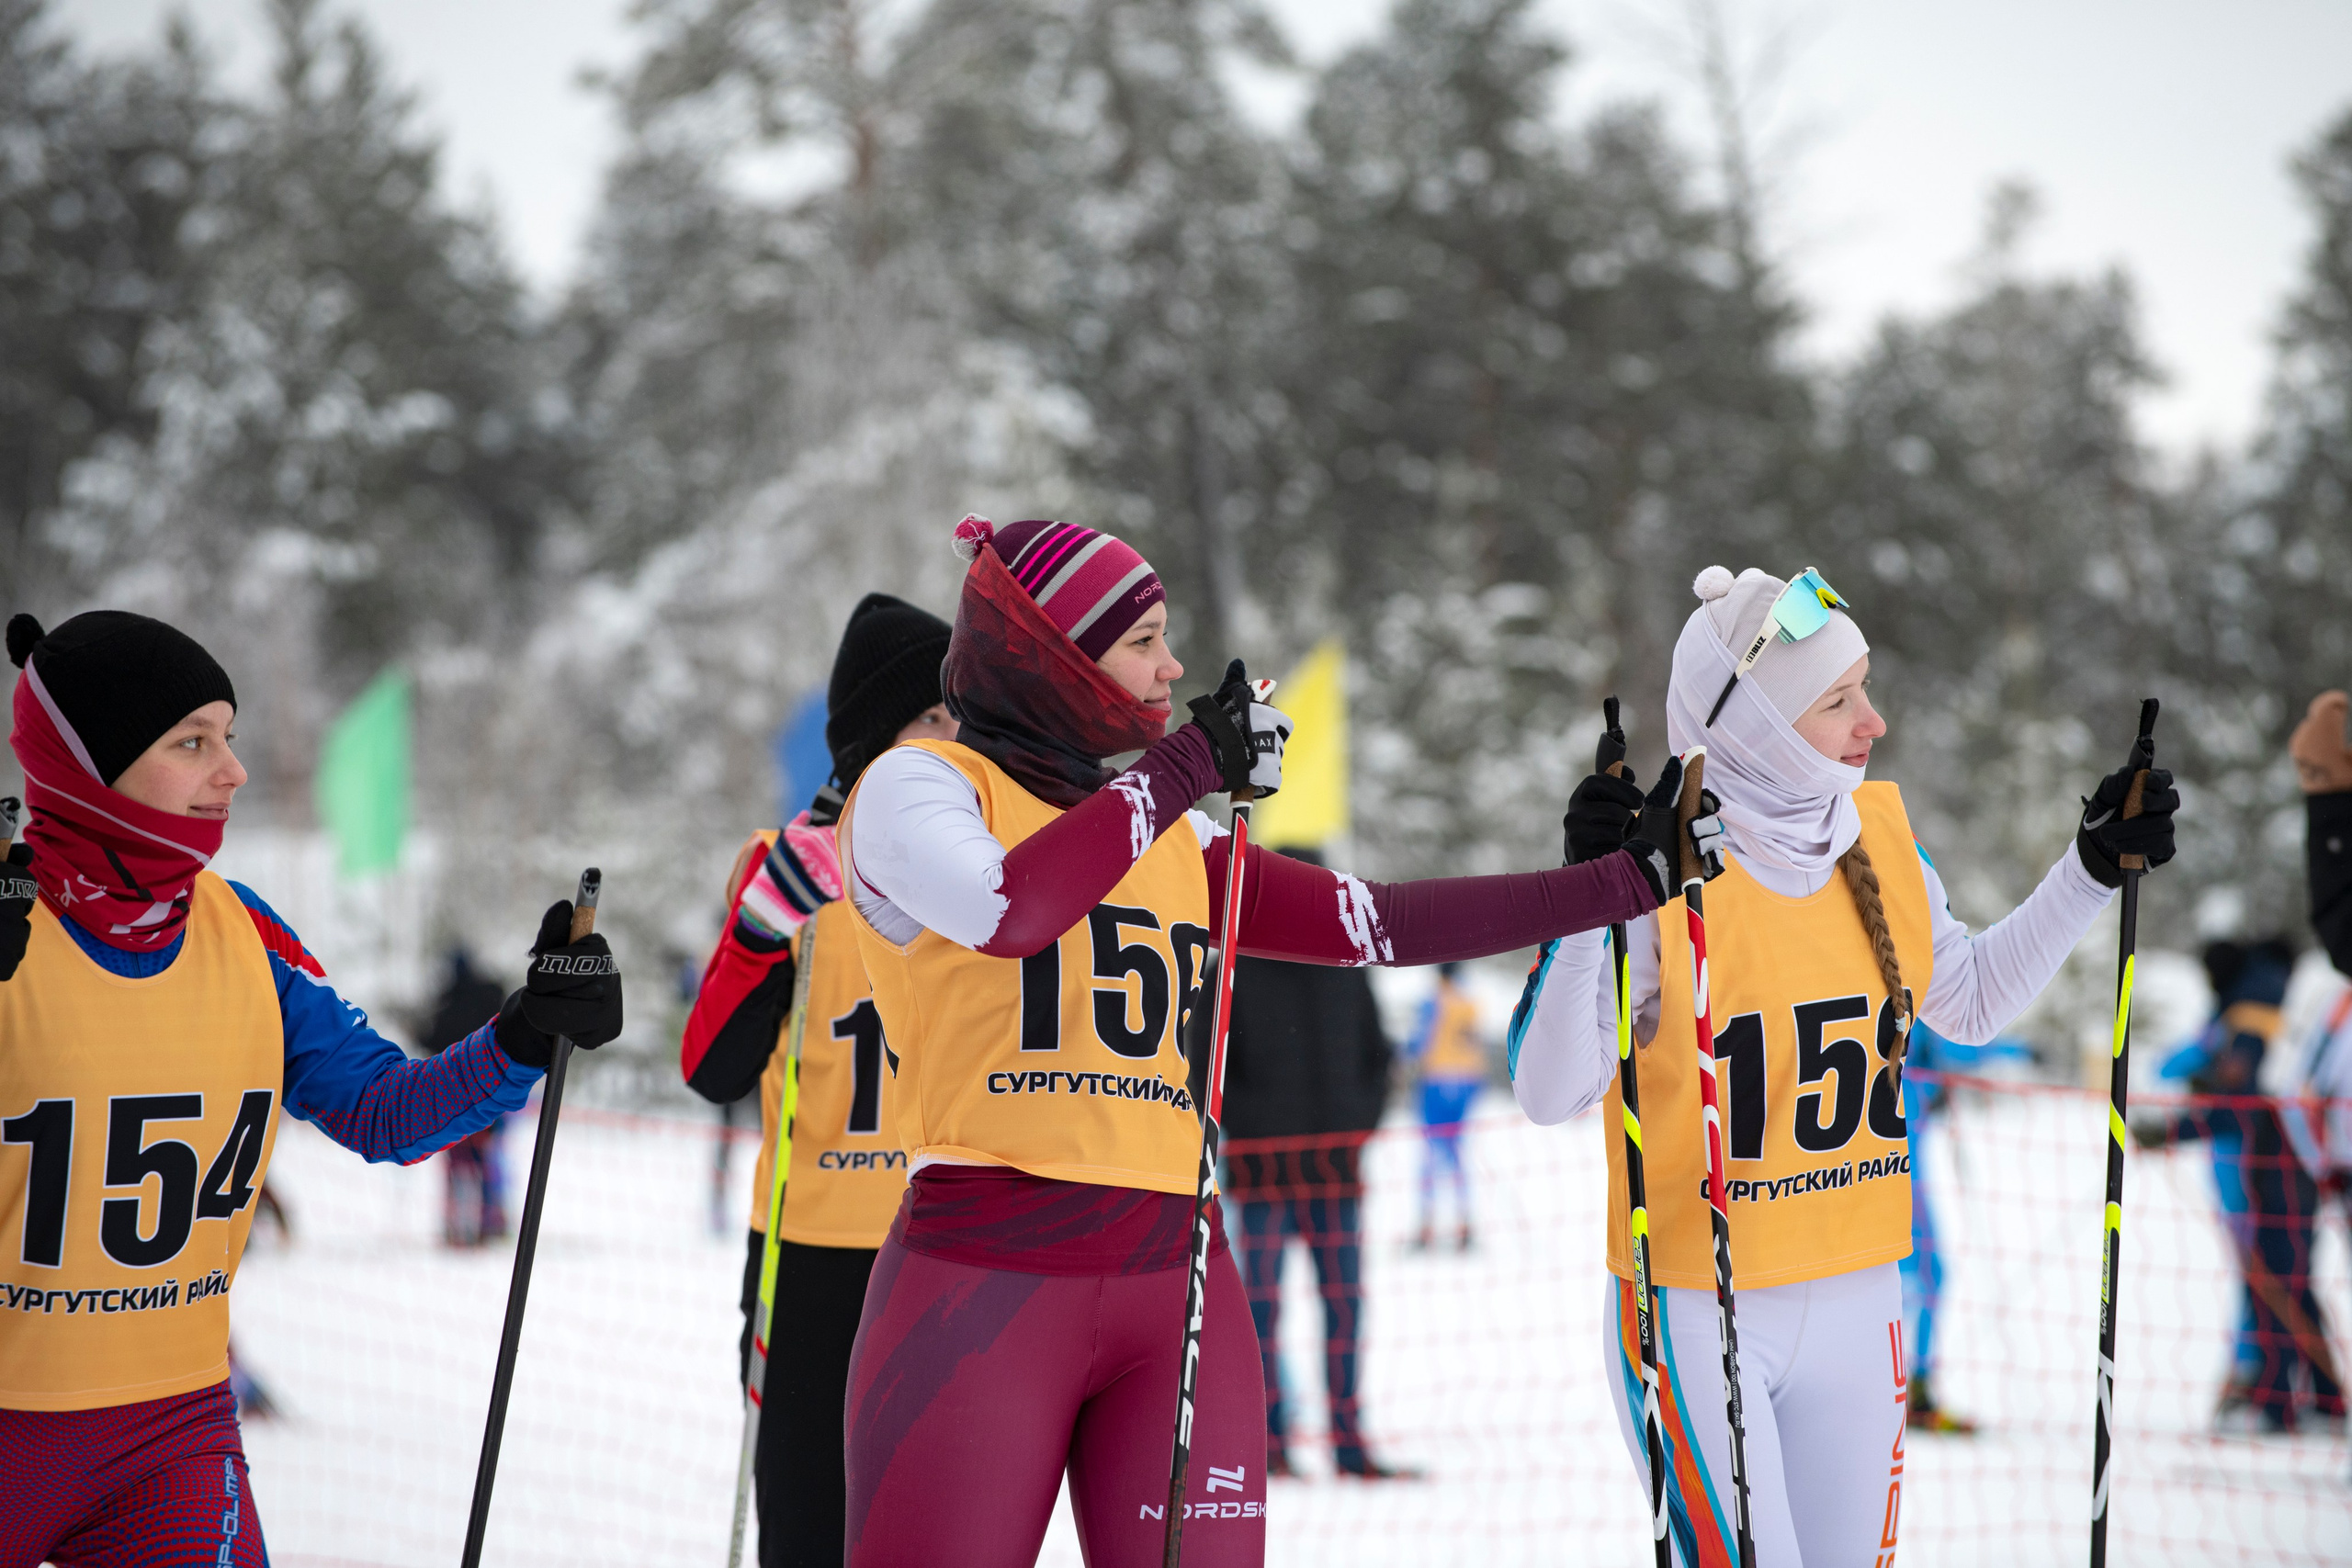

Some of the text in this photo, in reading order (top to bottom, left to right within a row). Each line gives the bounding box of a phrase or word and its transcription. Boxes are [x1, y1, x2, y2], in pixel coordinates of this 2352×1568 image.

[1713, 987, 1914, 1161] 158
[2, 1089, 275, 1270] 154
[1729, 1351, 1737, 1374] CARBON
